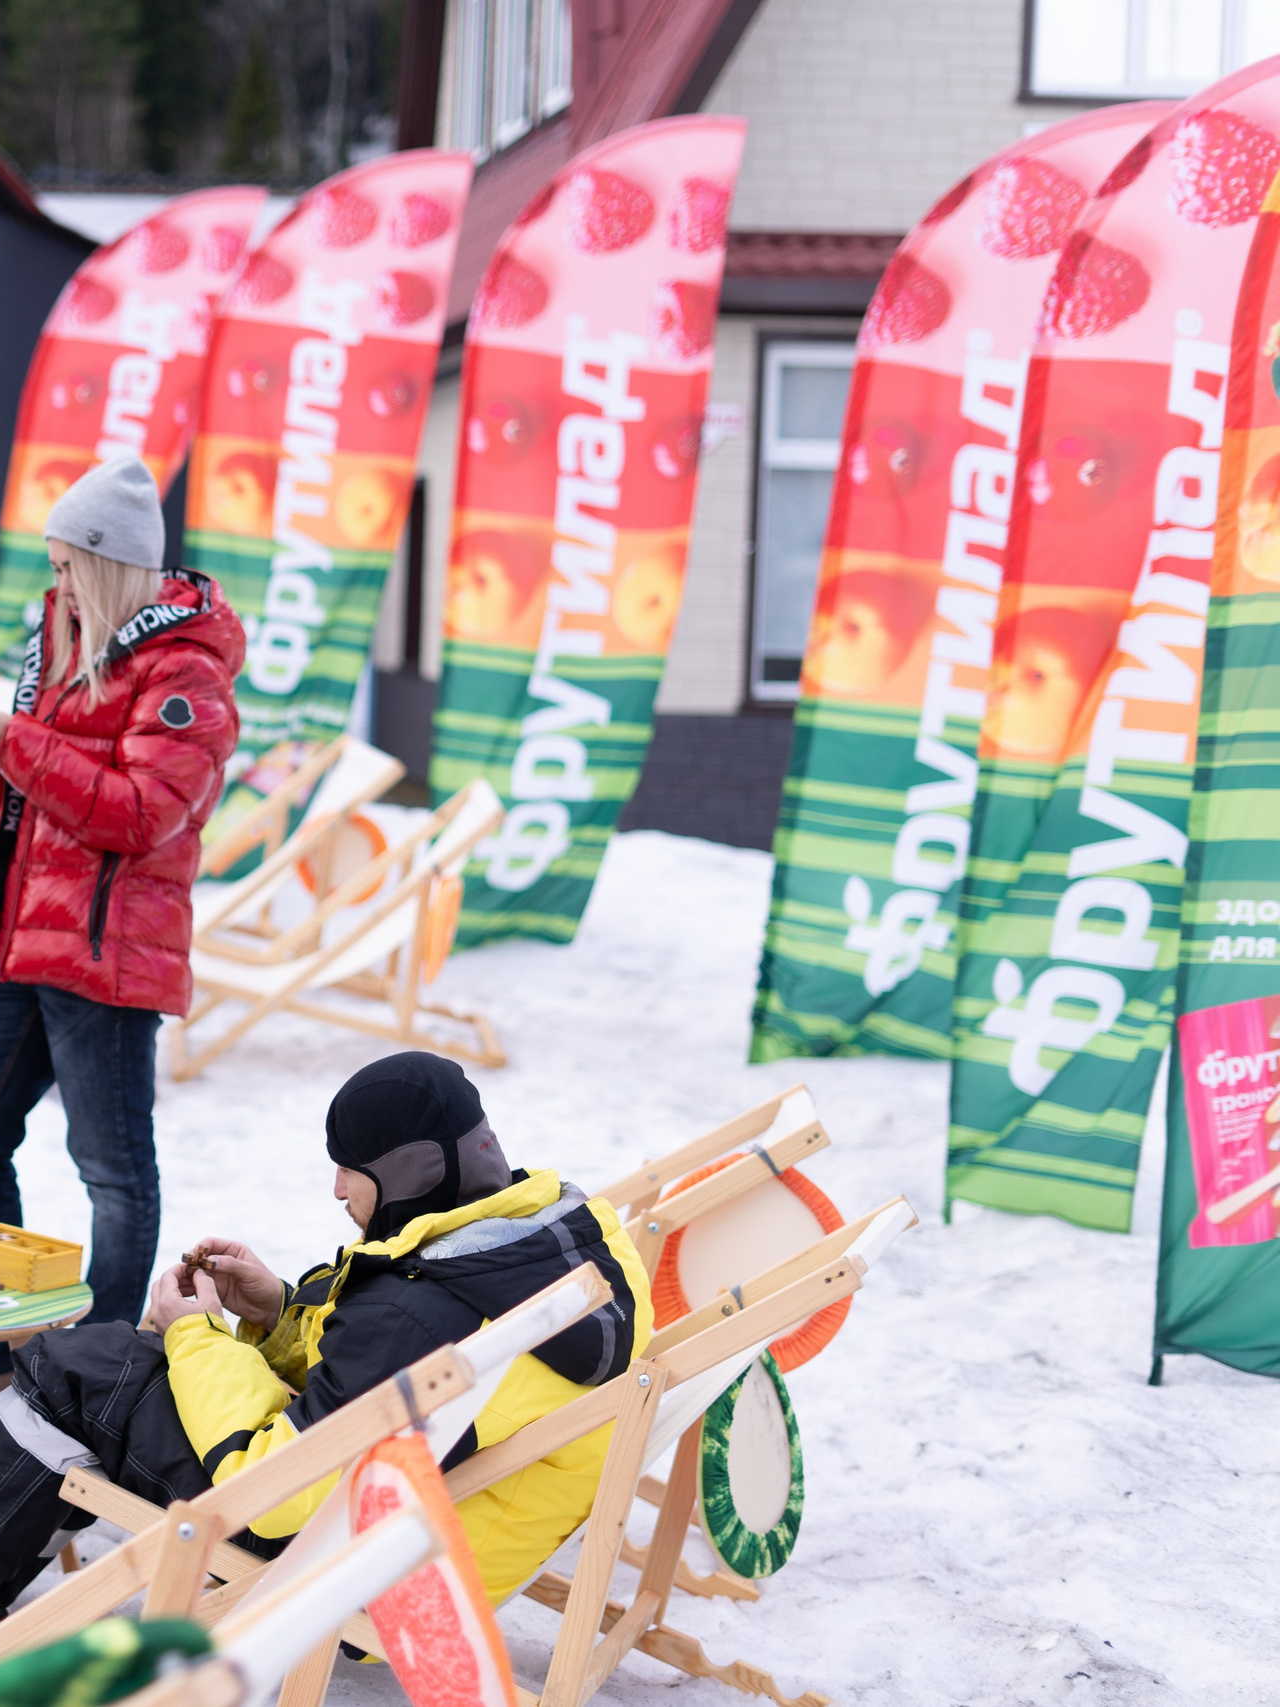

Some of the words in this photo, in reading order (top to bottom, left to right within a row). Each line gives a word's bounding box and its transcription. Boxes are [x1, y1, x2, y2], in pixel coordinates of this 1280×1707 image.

[116, 603, 198, 646] ONCLER
[1209, 935, 1277, 963] для
[1212, 1084, 1280, 1114] грано
[611, 1299, 626, 1321] umbia
